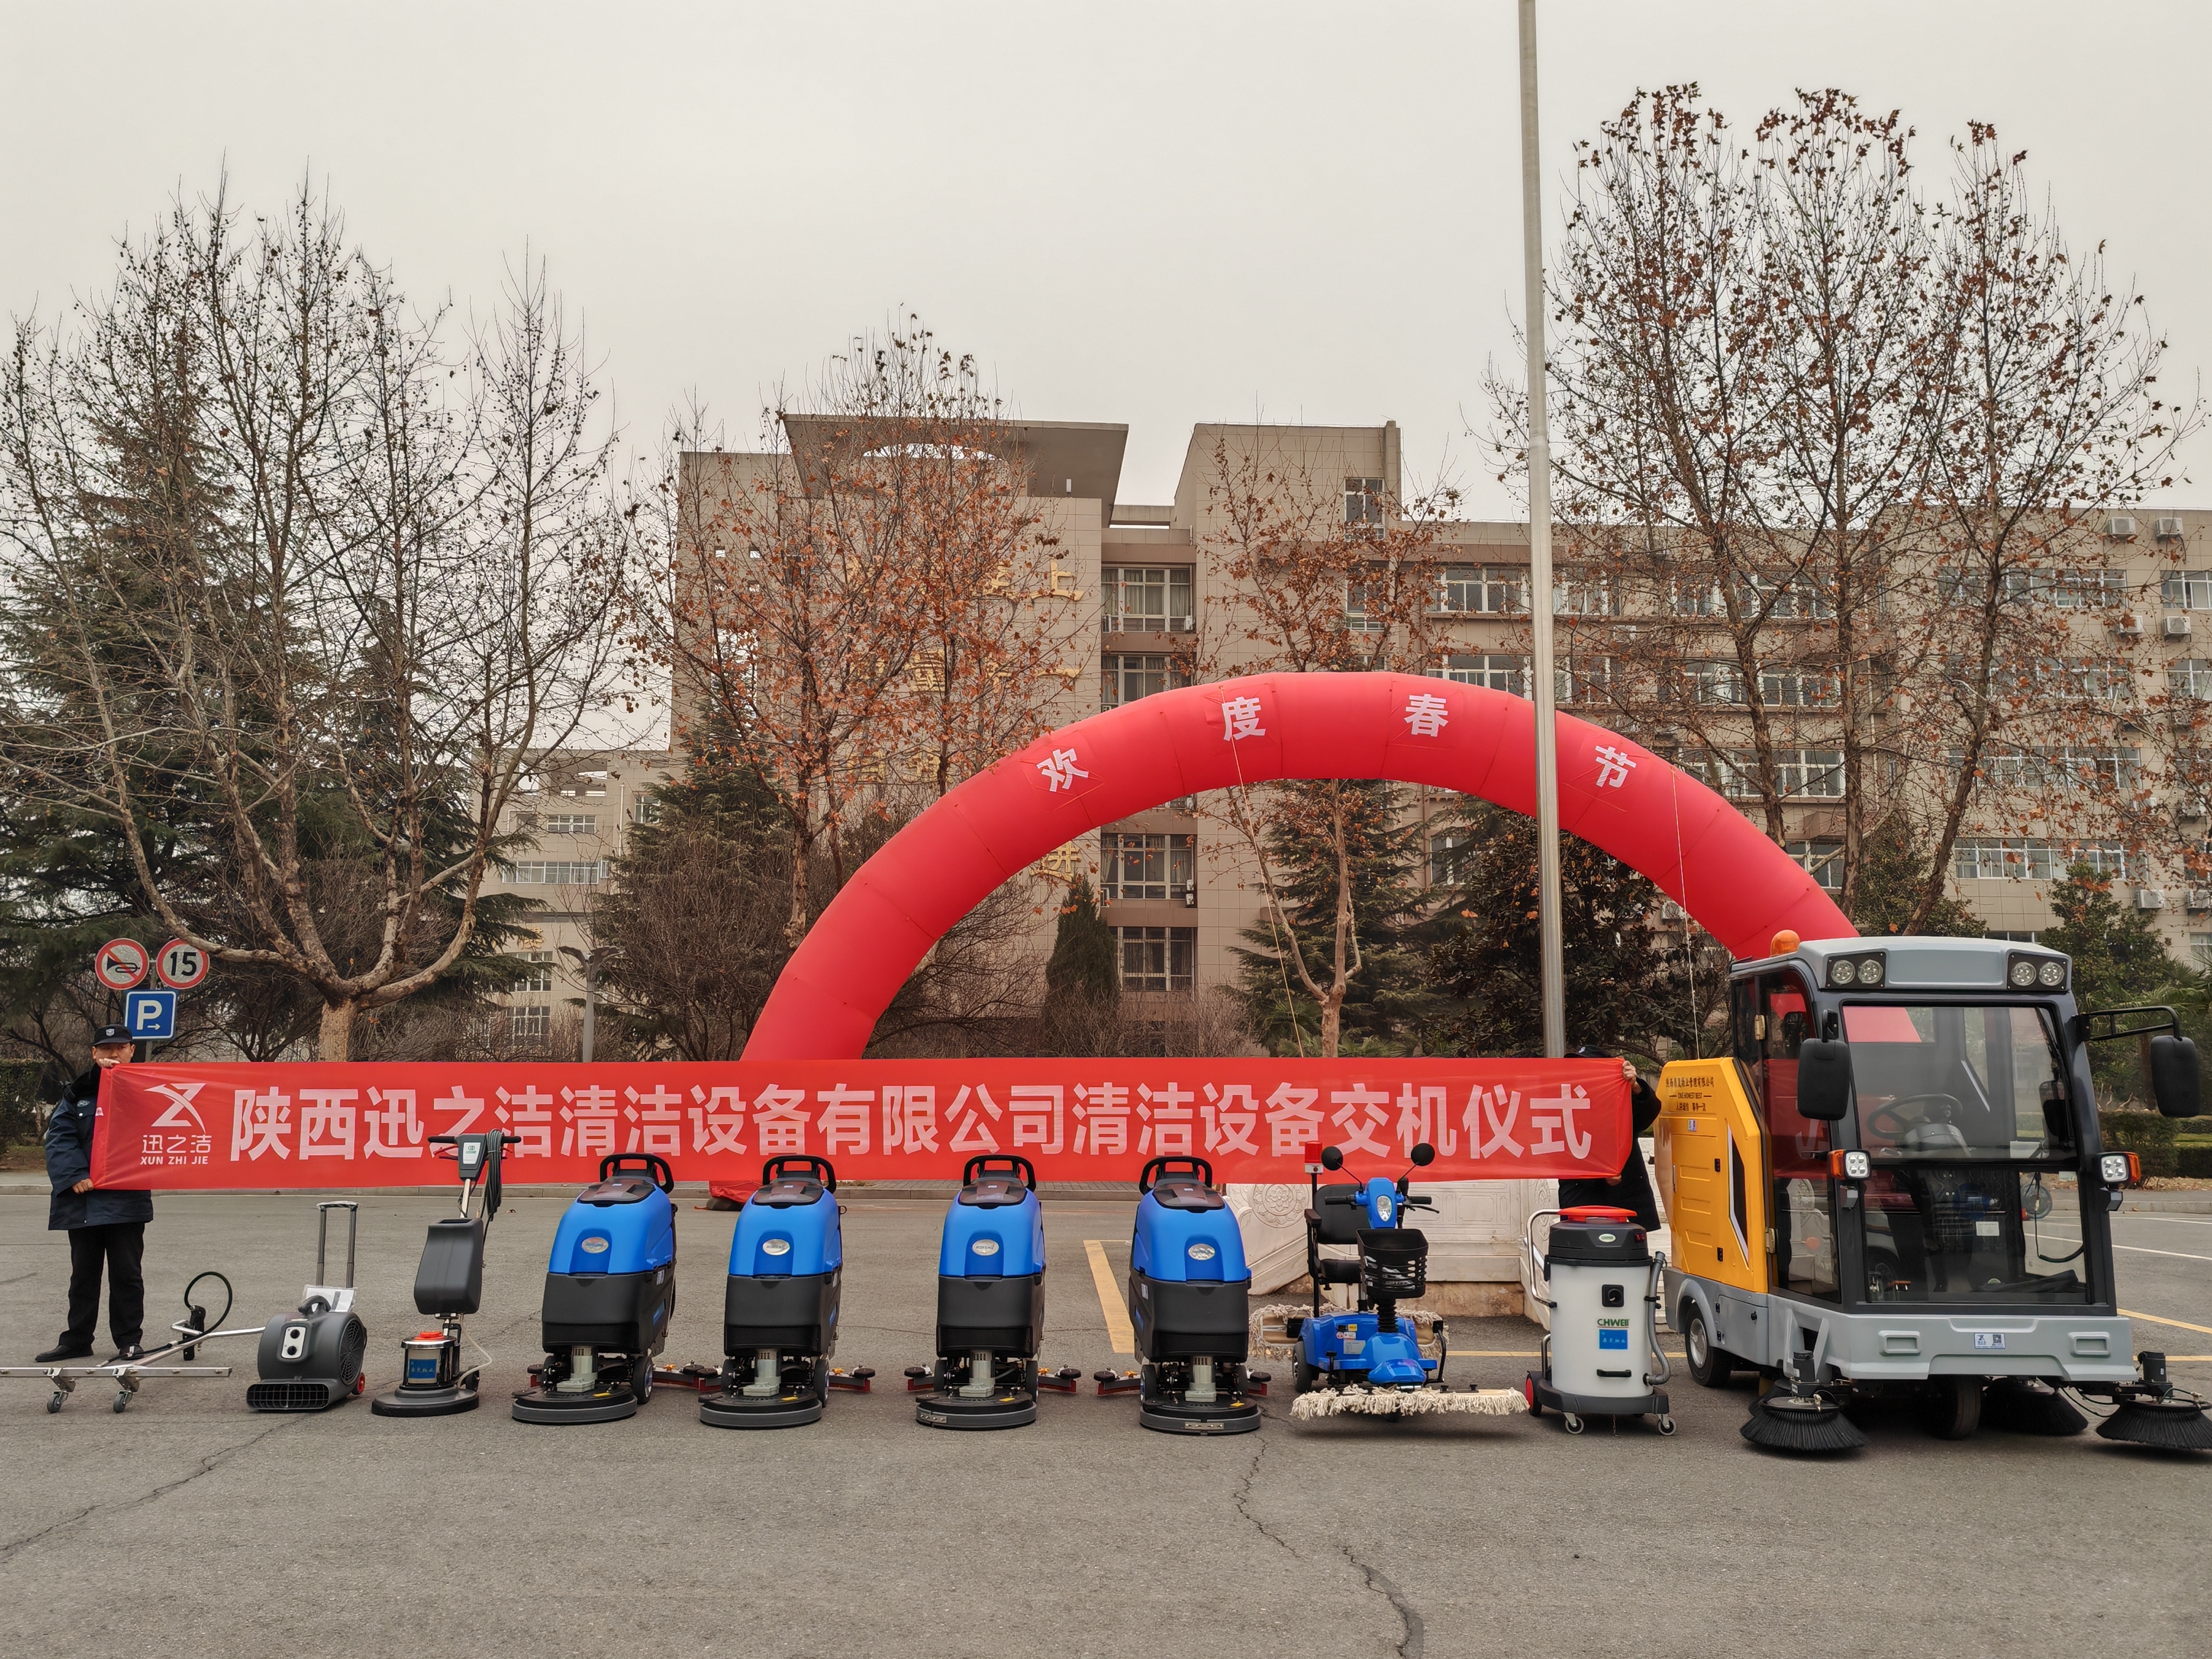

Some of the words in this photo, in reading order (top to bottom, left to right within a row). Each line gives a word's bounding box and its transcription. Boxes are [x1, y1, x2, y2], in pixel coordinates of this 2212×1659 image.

[1036, 693, 1637, 792] 欢度春节
[170, 952, 197, 976] 15
[137, 1000, 163, 1030] P
[231, 1082, 1592, 1162] 陕西迅之洁清洁设备有限公司清洁设备交机仪式
[142, 1134, 212, 1154] 迅之洁
[140, 1156, 163, 1165] XUN
[168, 1156, 187, 1165] ZHI
[191, 1156, 208, 1164] JIE
